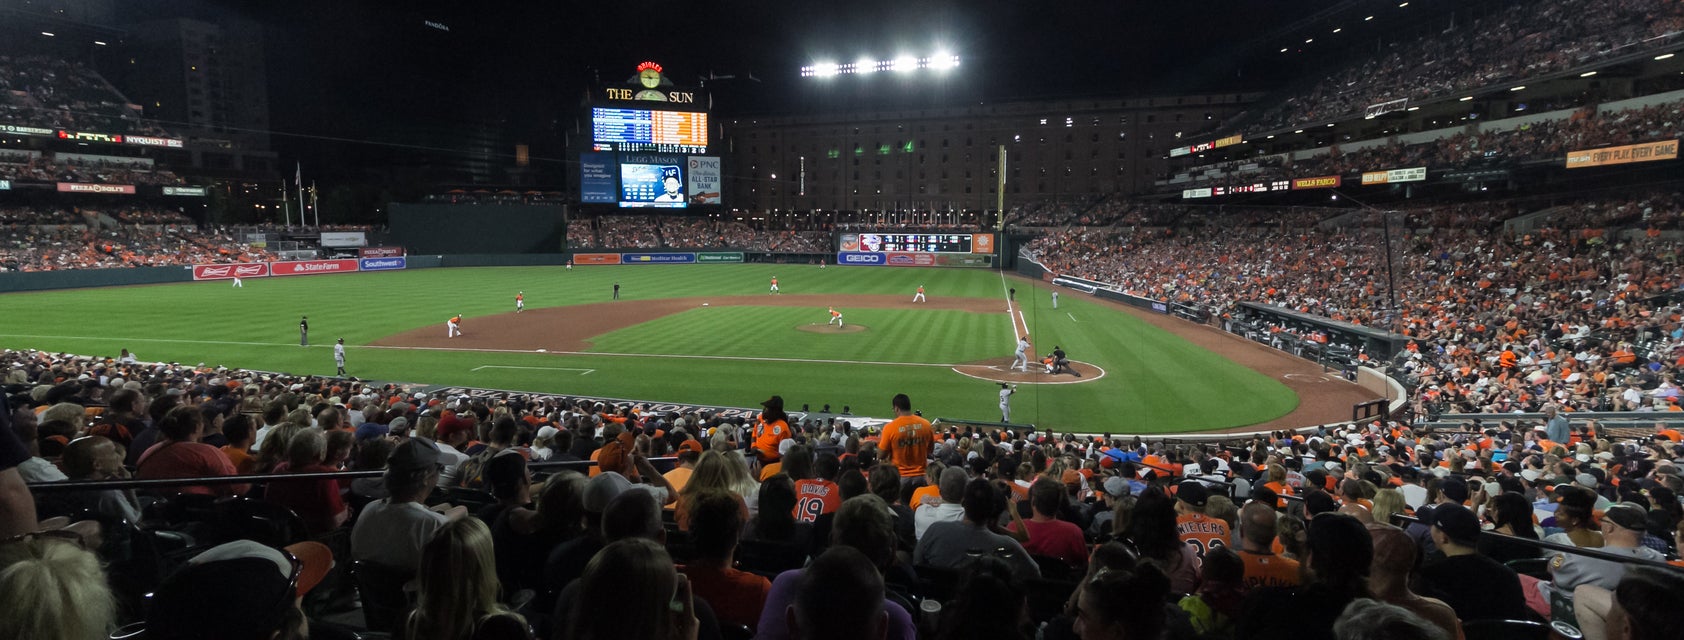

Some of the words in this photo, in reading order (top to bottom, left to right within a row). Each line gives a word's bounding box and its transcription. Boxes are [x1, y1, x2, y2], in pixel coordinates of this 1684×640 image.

[637, 61, 662, 72] ORIOLES
[606, 88, 633, 100] THE
[669, 91, 693, 103] SUN
[126, 136, 163, 145] NYQUIST
[1593, 151, 1612, 163] EVERY
[1631, 146, 1653, 159] EVERY
[700, 160, 718, 169] PNC
[1296, 179, 1315, 187] WELLS
[1315, 178, 1336, 186] FARGO
[846, 254, 878, 262] GEICO
[801, 484, 830, 496] DAVIS
[798, 497, 824, 523] 19
[1177, 521, 1225, 536] WIETERS
